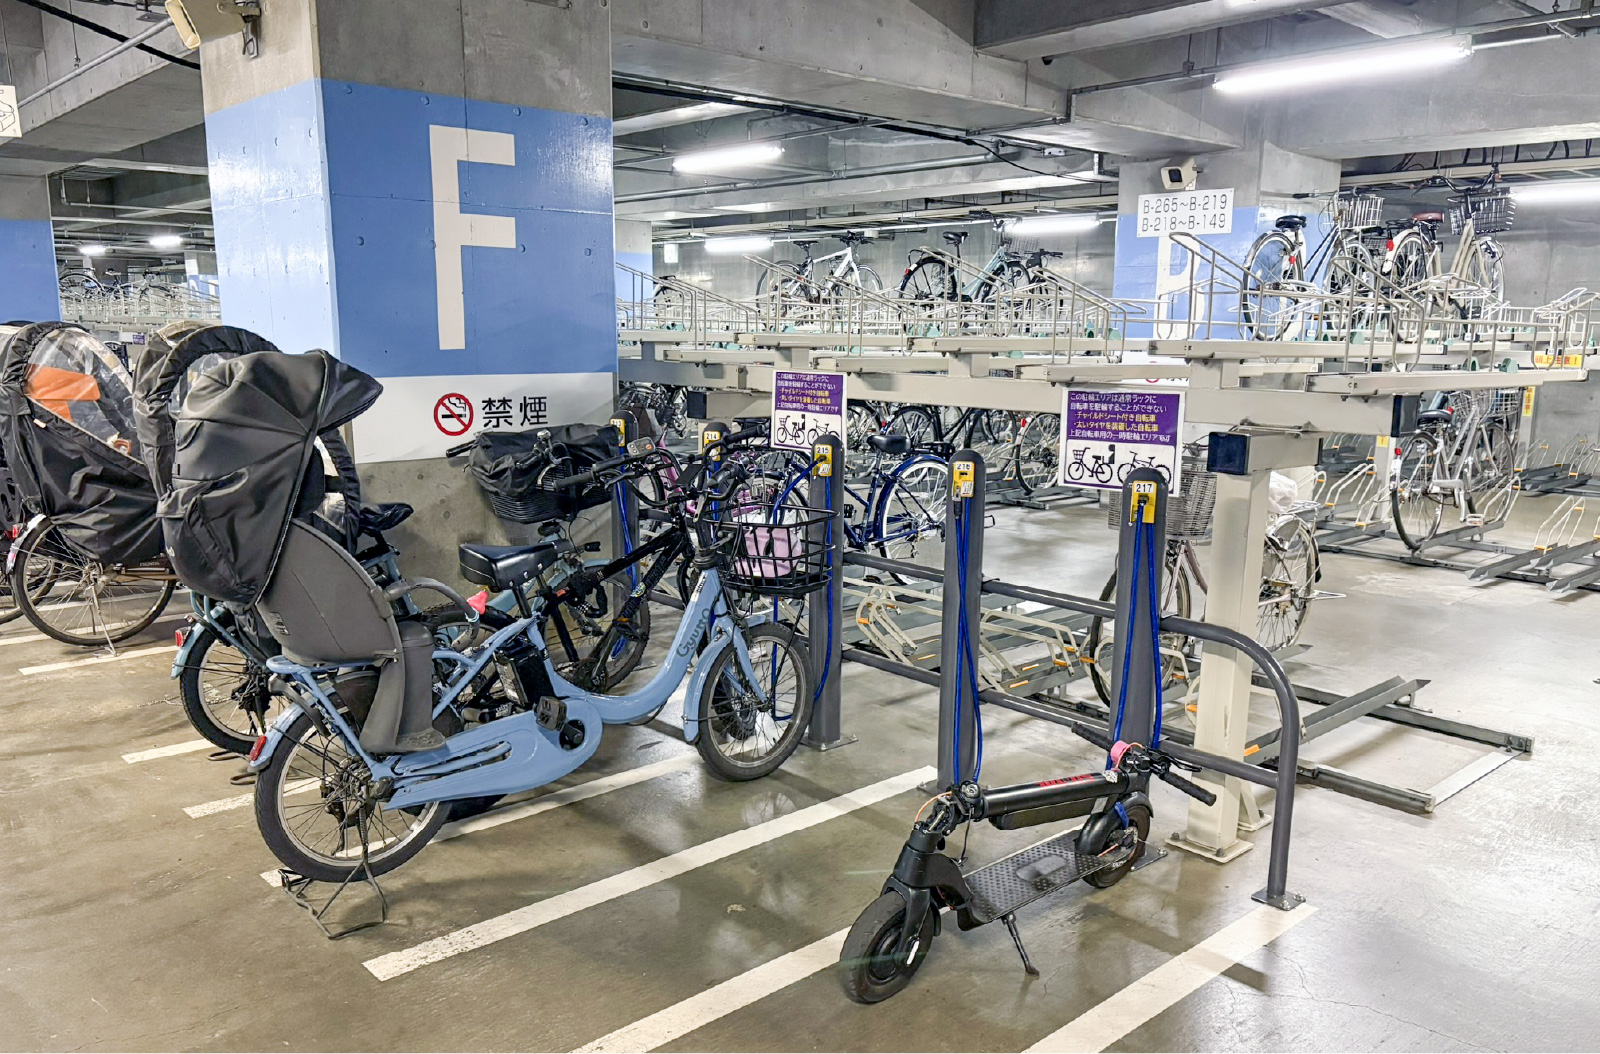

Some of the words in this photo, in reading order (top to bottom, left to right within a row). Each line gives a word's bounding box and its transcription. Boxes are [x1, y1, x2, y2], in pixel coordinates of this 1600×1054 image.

[429, 124, 516, 350] F
[482, 396, 548, 428] 禁煙
[706, 432, 718, 440] 214
[1136, 483, 1153, 493] 217
